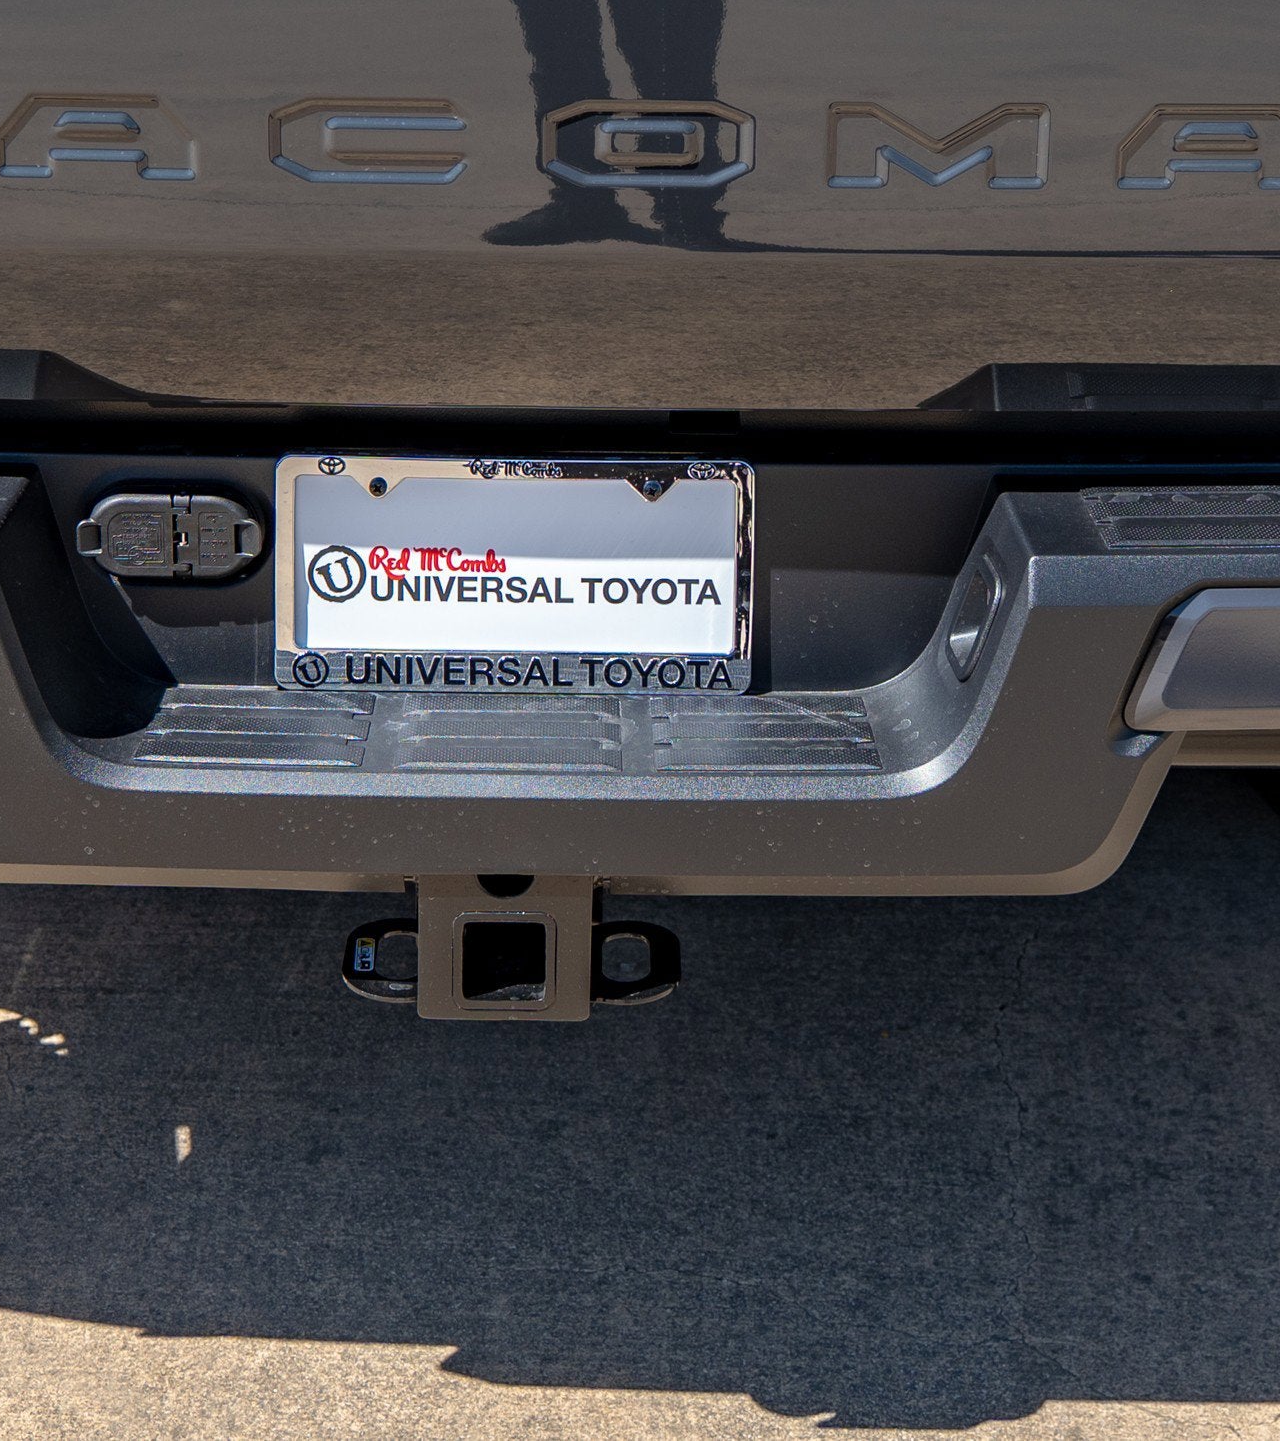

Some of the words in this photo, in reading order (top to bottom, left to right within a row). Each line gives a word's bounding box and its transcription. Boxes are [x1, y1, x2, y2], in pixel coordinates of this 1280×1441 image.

[369, 545, 410, 580] Red
[413, 547, 507, 573] McCombs
[371, 575, 574, 604] UNIVERSAL
[581, 577, 721, 605] TOYOTA
[345, 654, 573, 687] UNIVERSAL
[579, 657, 733, 688] TOYOTA
